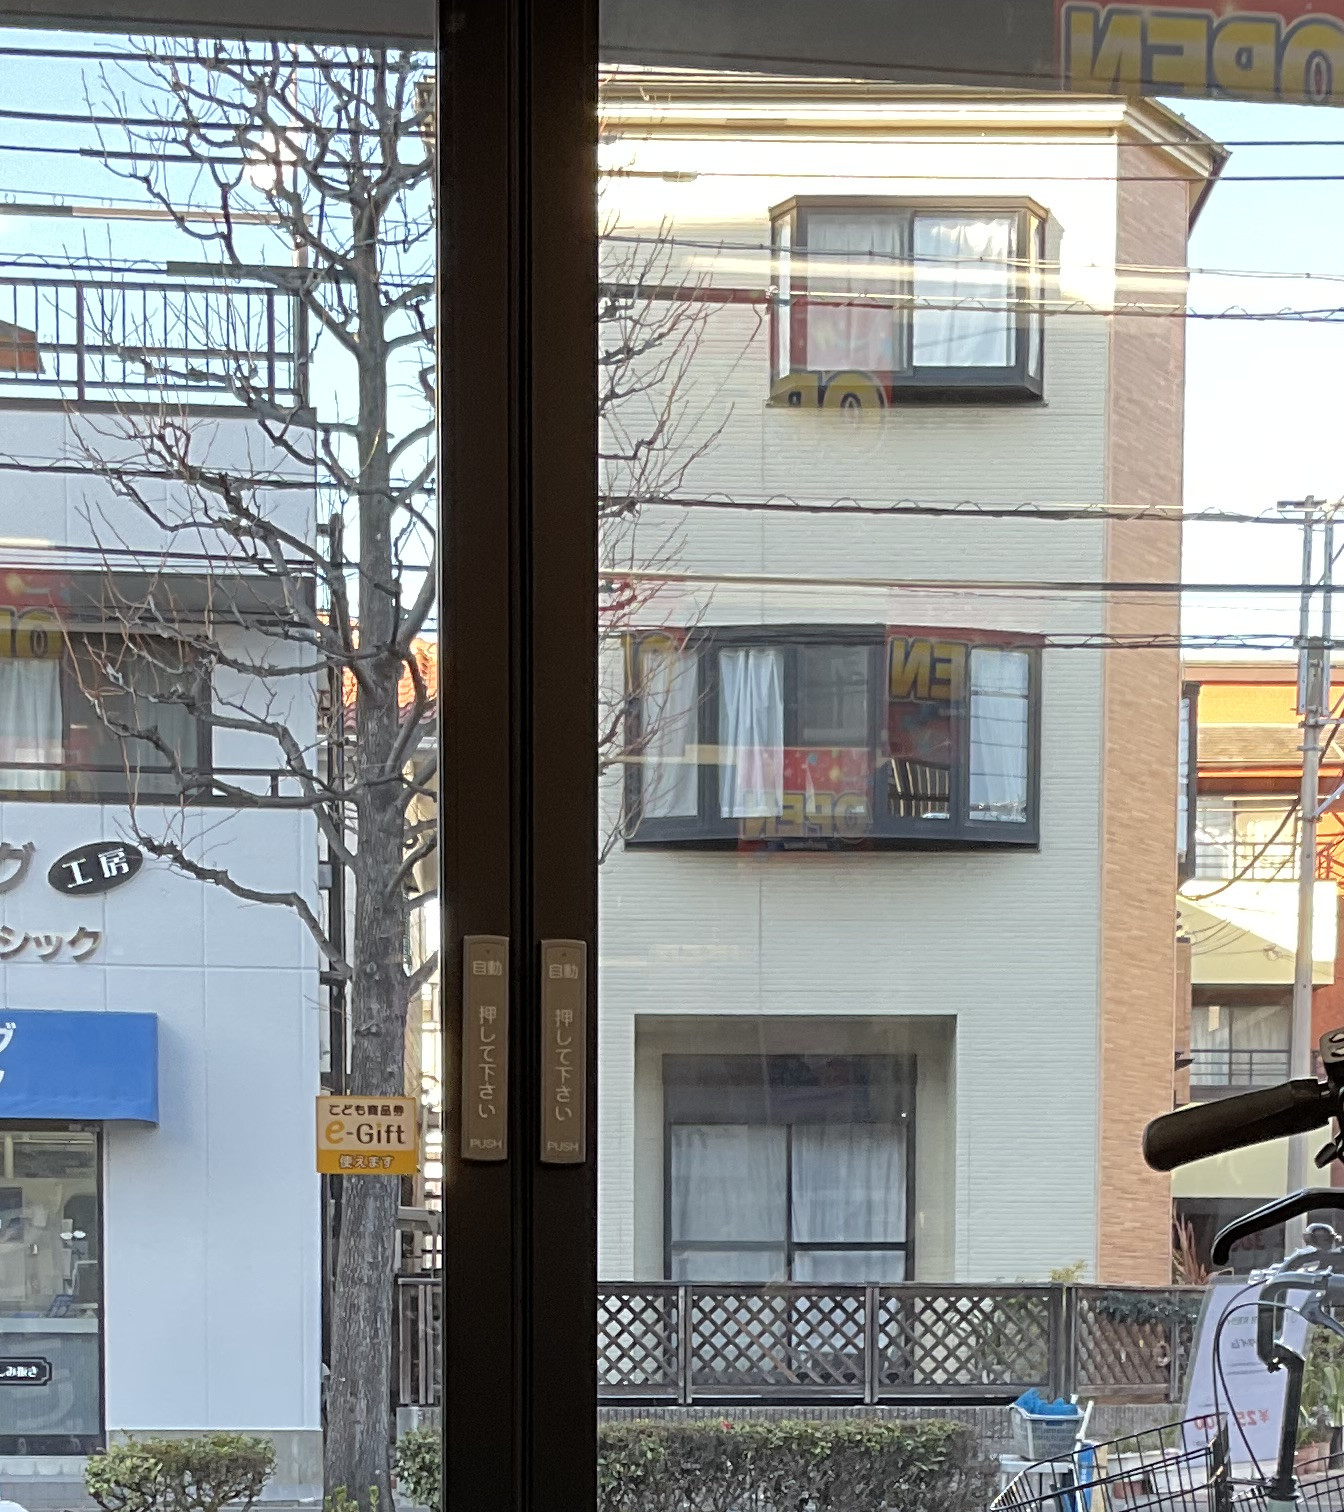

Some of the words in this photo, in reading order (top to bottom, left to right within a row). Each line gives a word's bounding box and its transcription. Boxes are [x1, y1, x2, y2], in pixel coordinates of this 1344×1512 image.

[61, 851, 132, 889] 工房
[472, 960, 503, 976] 自動
[548, 963, 579, 979] 自動
[478, 1005, 497, 1118] 押して下さい
[555, 1008, 574, 1121] 押して下さい
[328, 1104, 405, 1117] こども商品券
[325, 1119, 406, 1145] e-Gift
[469, 1138, 503, 1150] PUSH
[547, 1141, 579, 1152] PUSH
[339, 1154, 394, 1169] 使えます
